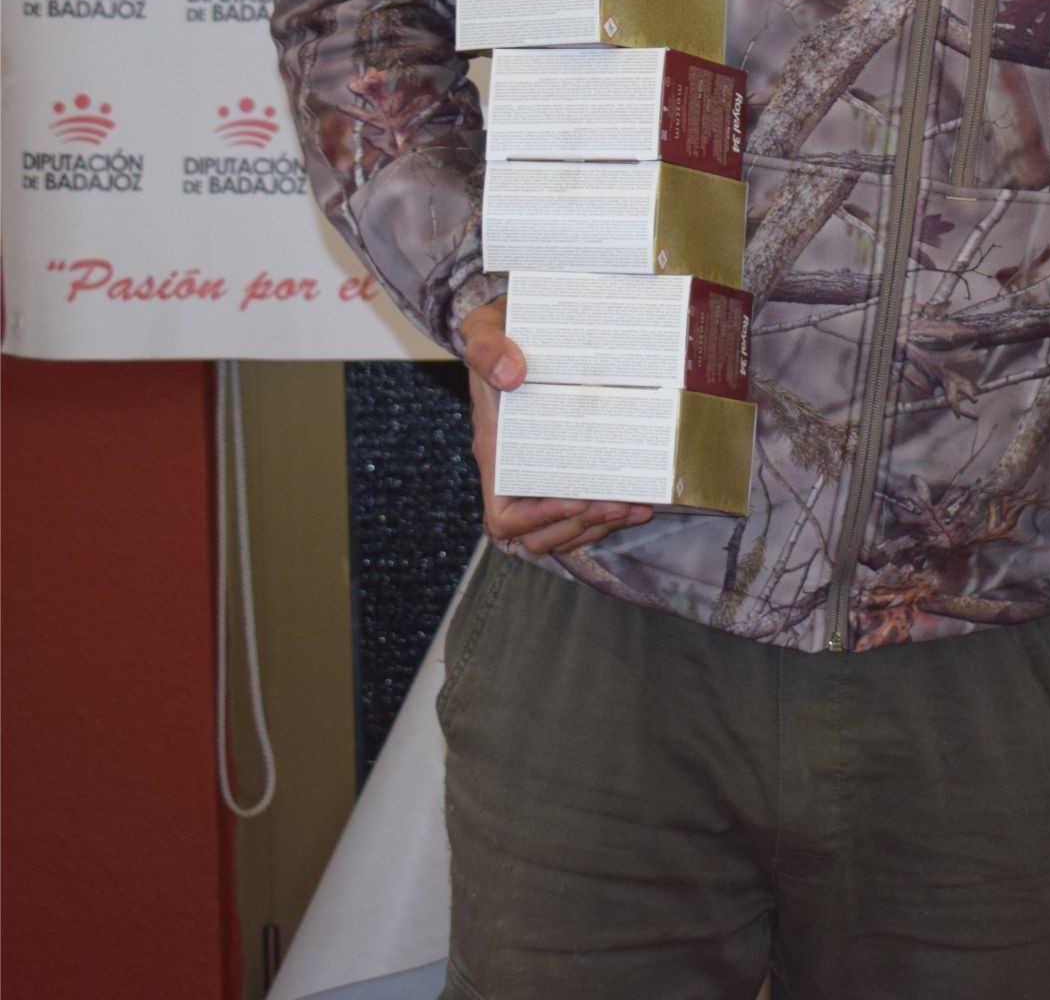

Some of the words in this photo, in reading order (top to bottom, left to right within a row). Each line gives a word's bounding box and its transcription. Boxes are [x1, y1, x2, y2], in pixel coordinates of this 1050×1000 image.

[24, 2, 41, 16] DE
[49, 0, 147, 19] BADAJOZ
[187, 9, 205, 21] DE
[212, 4, 272, 22] BADA
[23, 150, 144, 172] DIPUTACIÓN
[184, 153, 306, 175] DIPUTACIÓN
[23, 175, 39, 189] DE
[46, 173, 143, 191] BADAJOZ
[184, 180, 201, 193] DE
[209, 176, 307, 195] BADAJOZ
[240, 270, 319, 312] por
[339, 275, 380, 302] el
